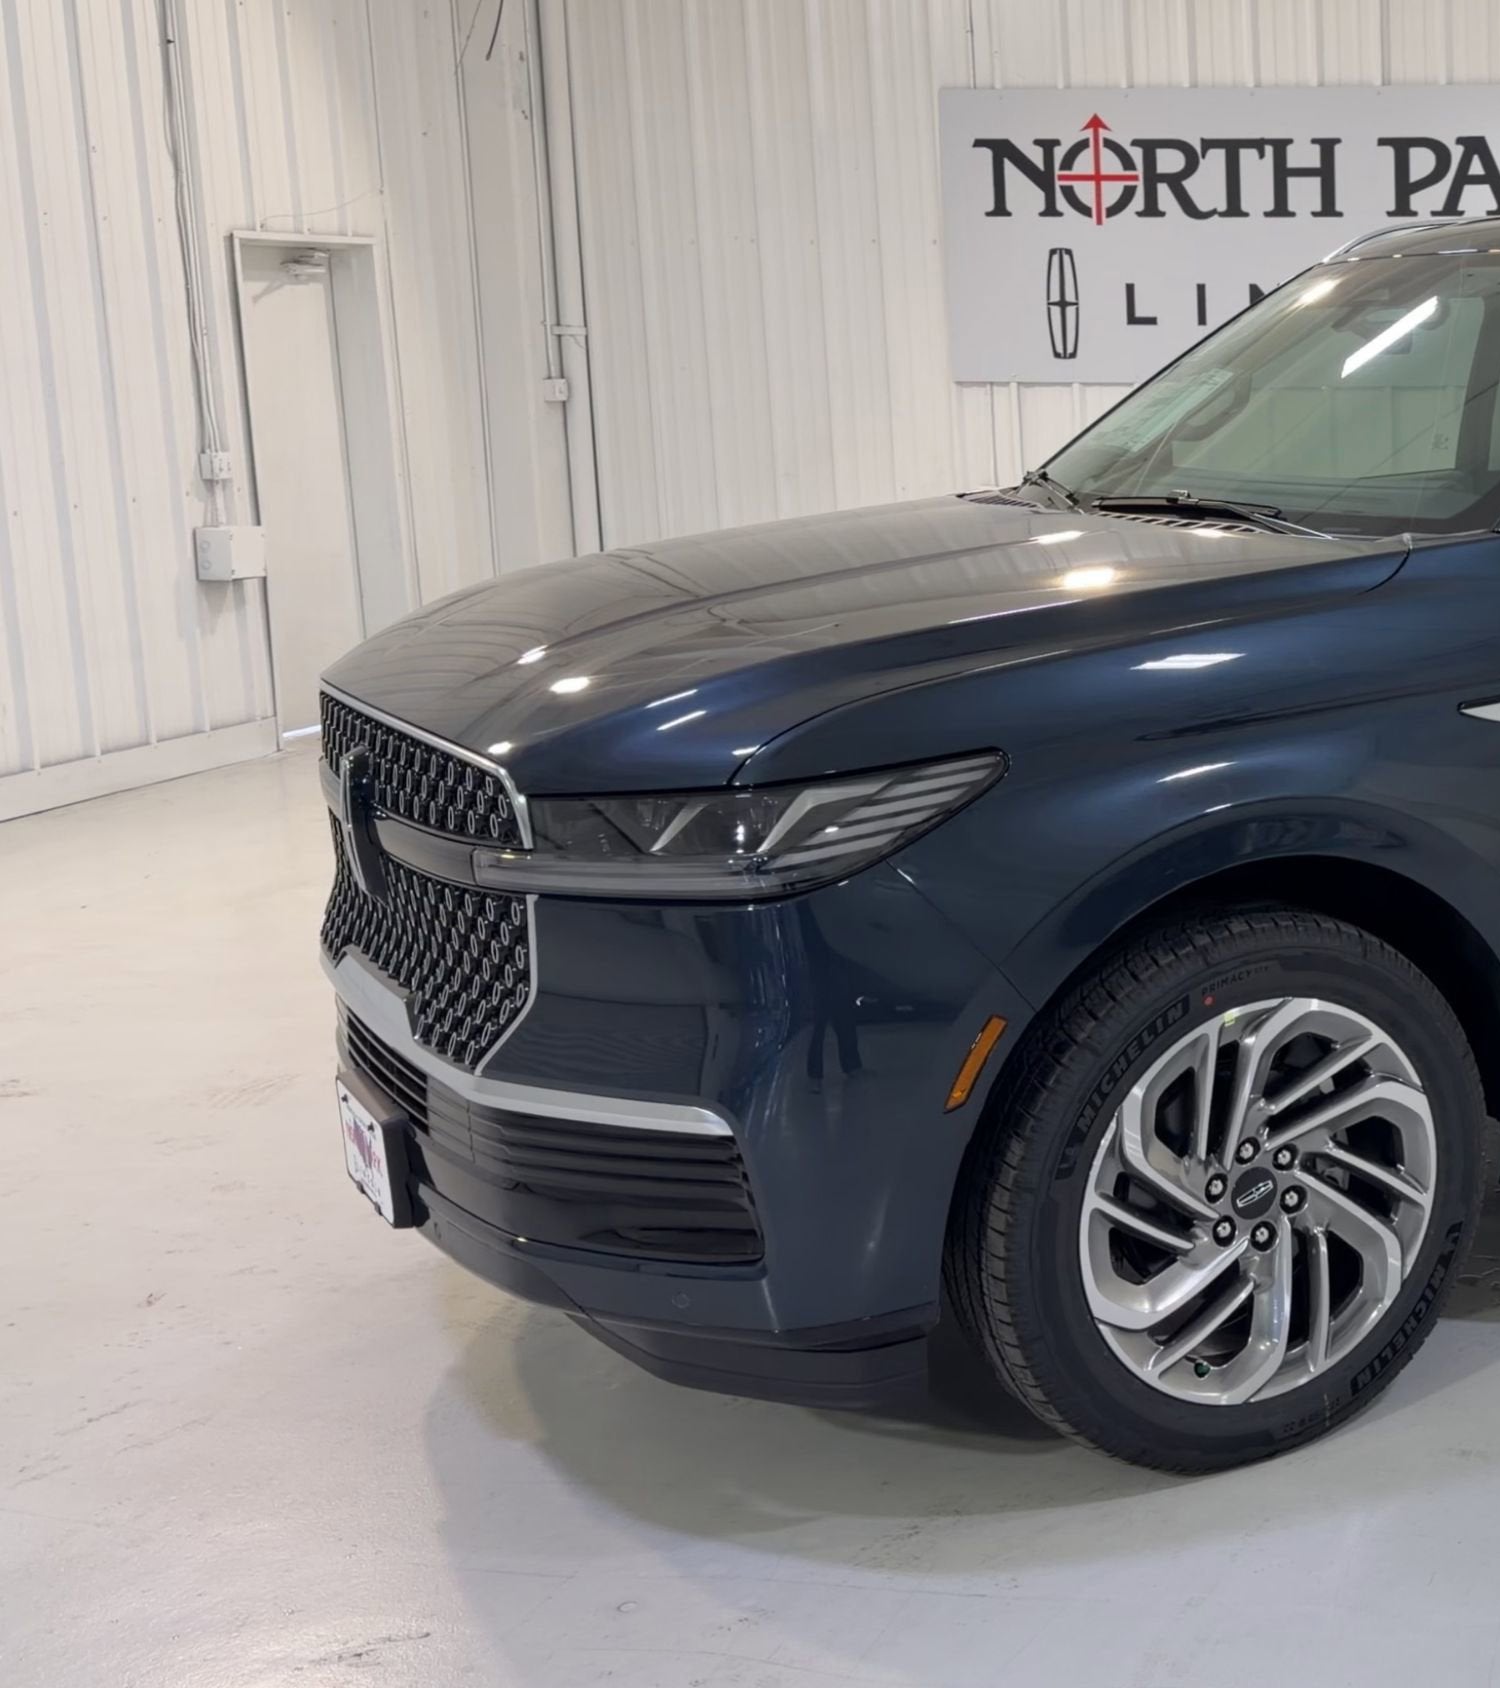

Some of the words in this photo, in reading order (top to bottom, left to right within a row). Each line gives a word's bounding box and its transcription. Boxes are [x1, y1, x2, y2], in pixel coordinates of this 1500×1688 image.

[972, 134, 1344, 221] NORTH
[1075, 998, 1187, 1135] MICHELIN
[1201, 969, 1252, 996] PRIMACY
[1355, 1262, 1448, 1392] MICHELIN
